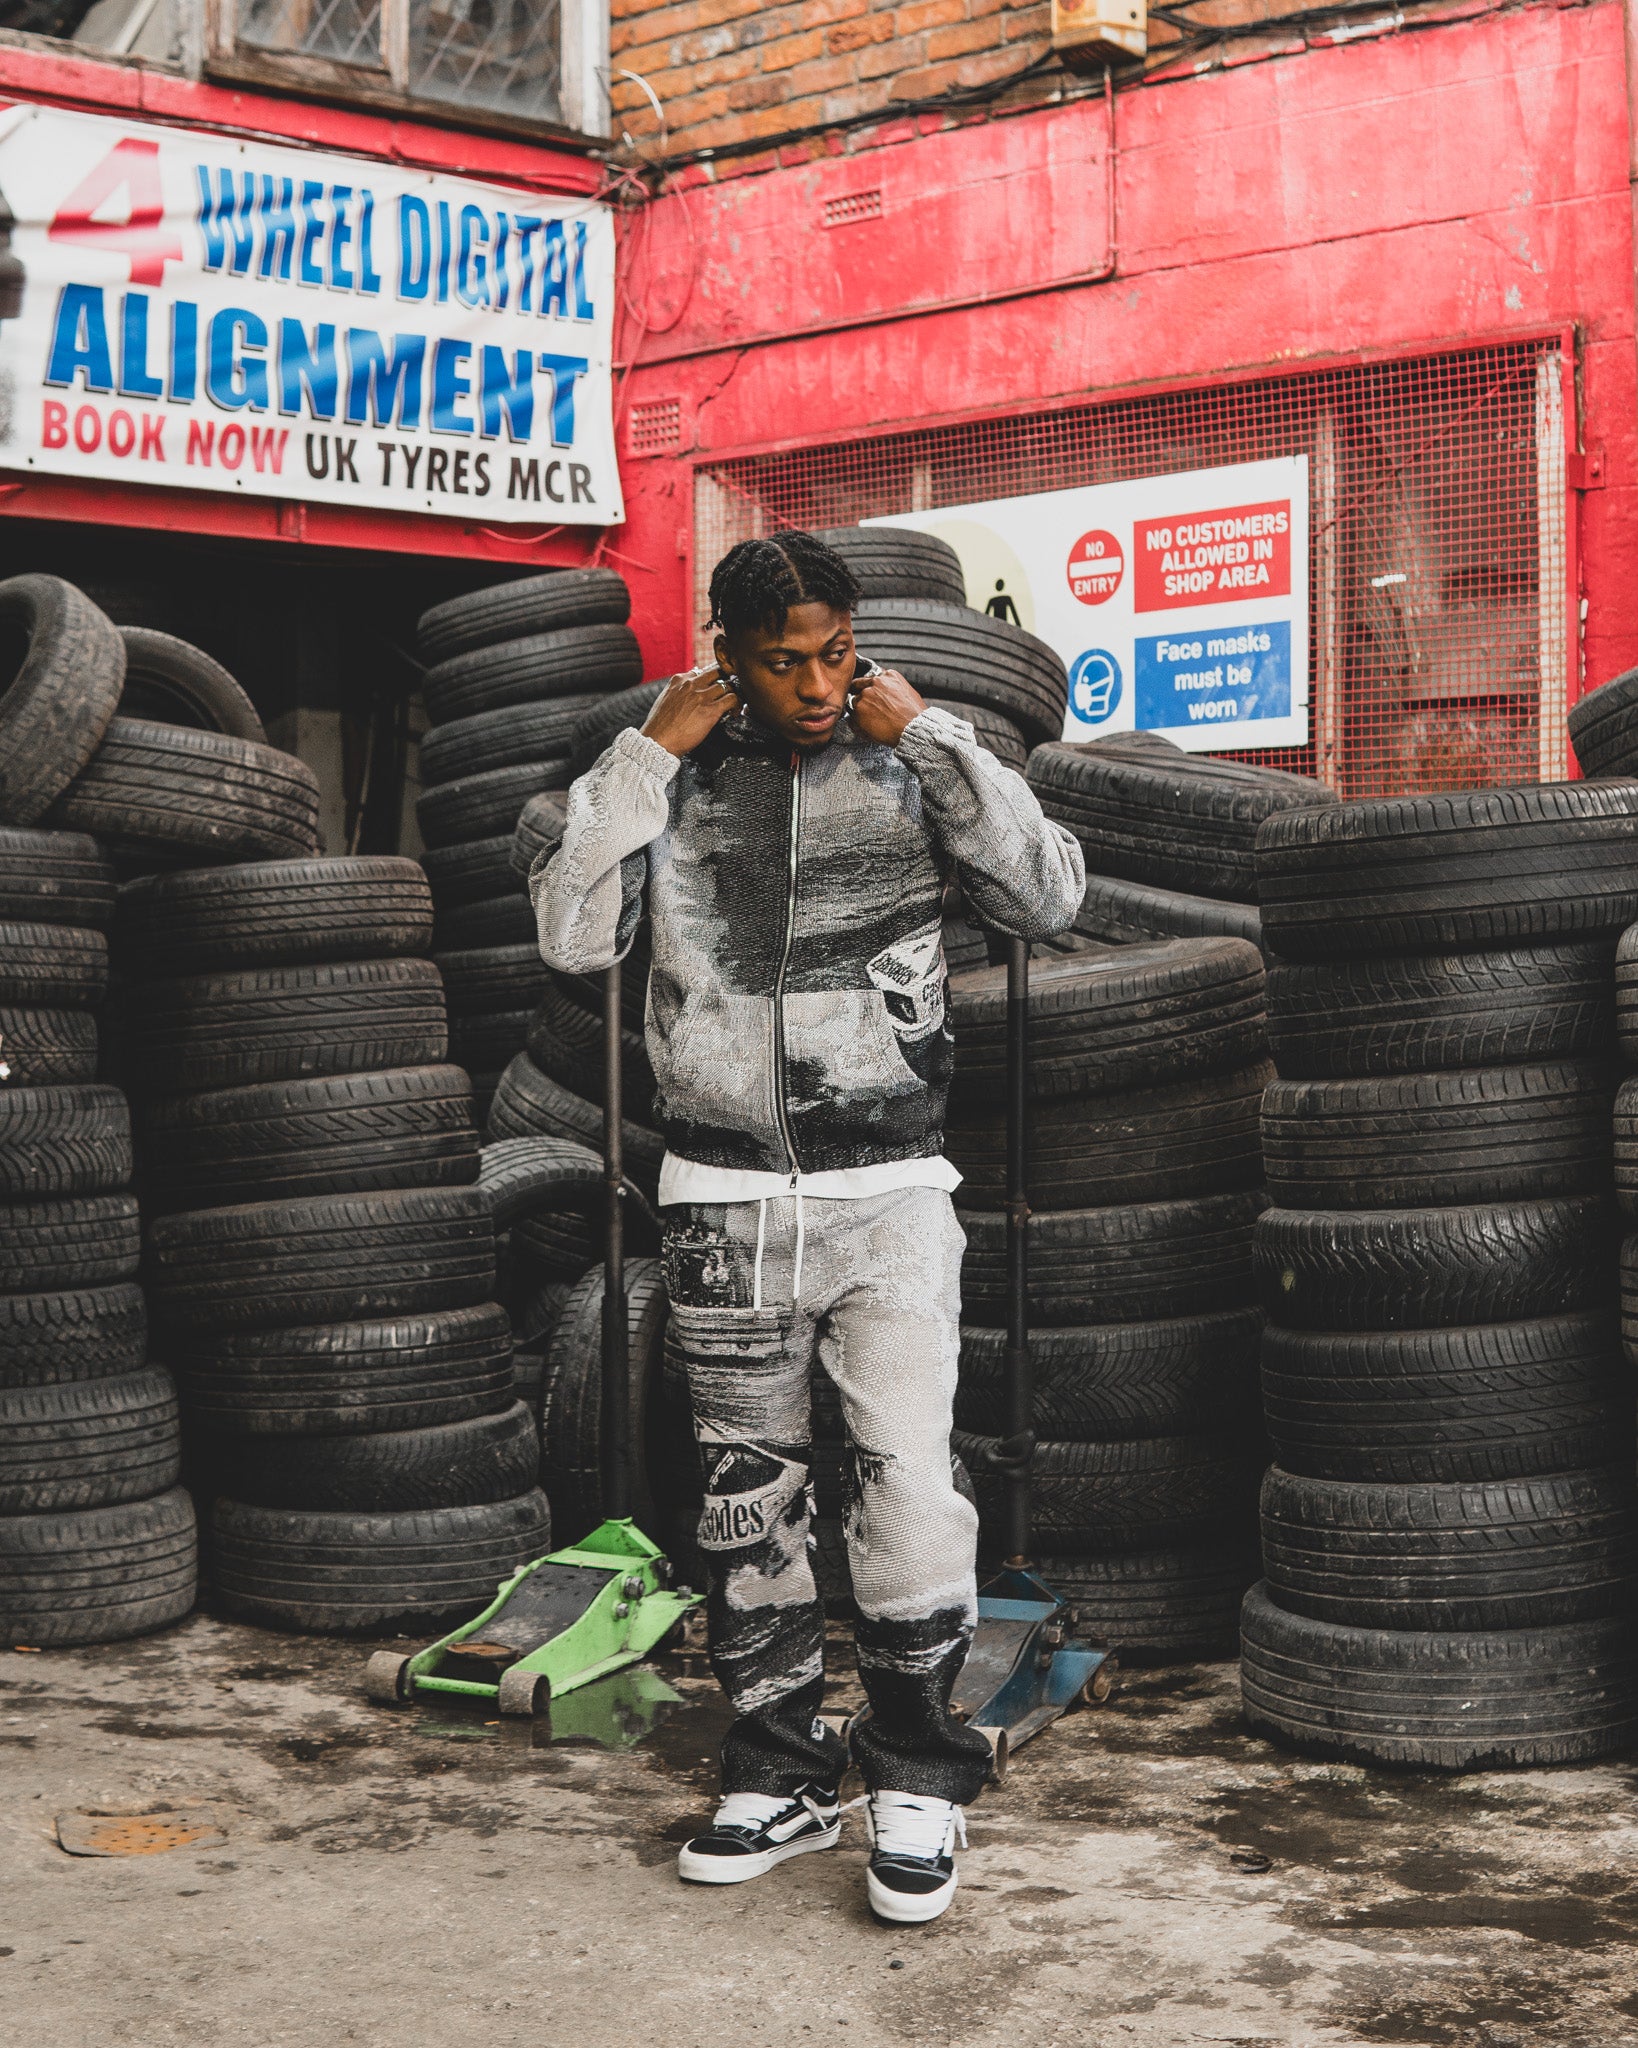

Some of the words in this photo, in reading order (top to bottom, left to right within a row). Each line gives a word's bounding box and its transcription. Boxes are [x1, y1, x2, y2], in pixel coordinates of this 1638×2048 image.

[48, 137, 183, 287] 4
[195, 165, 382, 295] WHEEL
[394, 195, 596, 322] DIGITAL
[43, 283, 589, 448] ALIGNMENT
[41, 399, 166, 463] BOOK
[186, 418, 290, 475] NOW
[305, 432, 360, 483] UK
[378, 441, 491, 496] TYRES
[508, 457, 596, 504] MCR
[1146, 528, 1172, 551] NO
[1176, 512, 1289, 544] CUSTOMERS
[1086, 541, 1105, 557] NO
[1160, 545, 1249, 573] ALLOWED
[1253, 538, 1273, 560] IN
[1074, 576, 1117, 596] ENTRY
[1164, 570, 1214, 596] SHOP
[1218, 563, 1270, 589] AREA
[1156, 640, 1203, 662] Face
[1207, 631, 1271, 657] masks
[1174, 670, 1223, 691] must
[1227, 663, 1252, 685] be
[1188, 699, 1237, 720] worn
